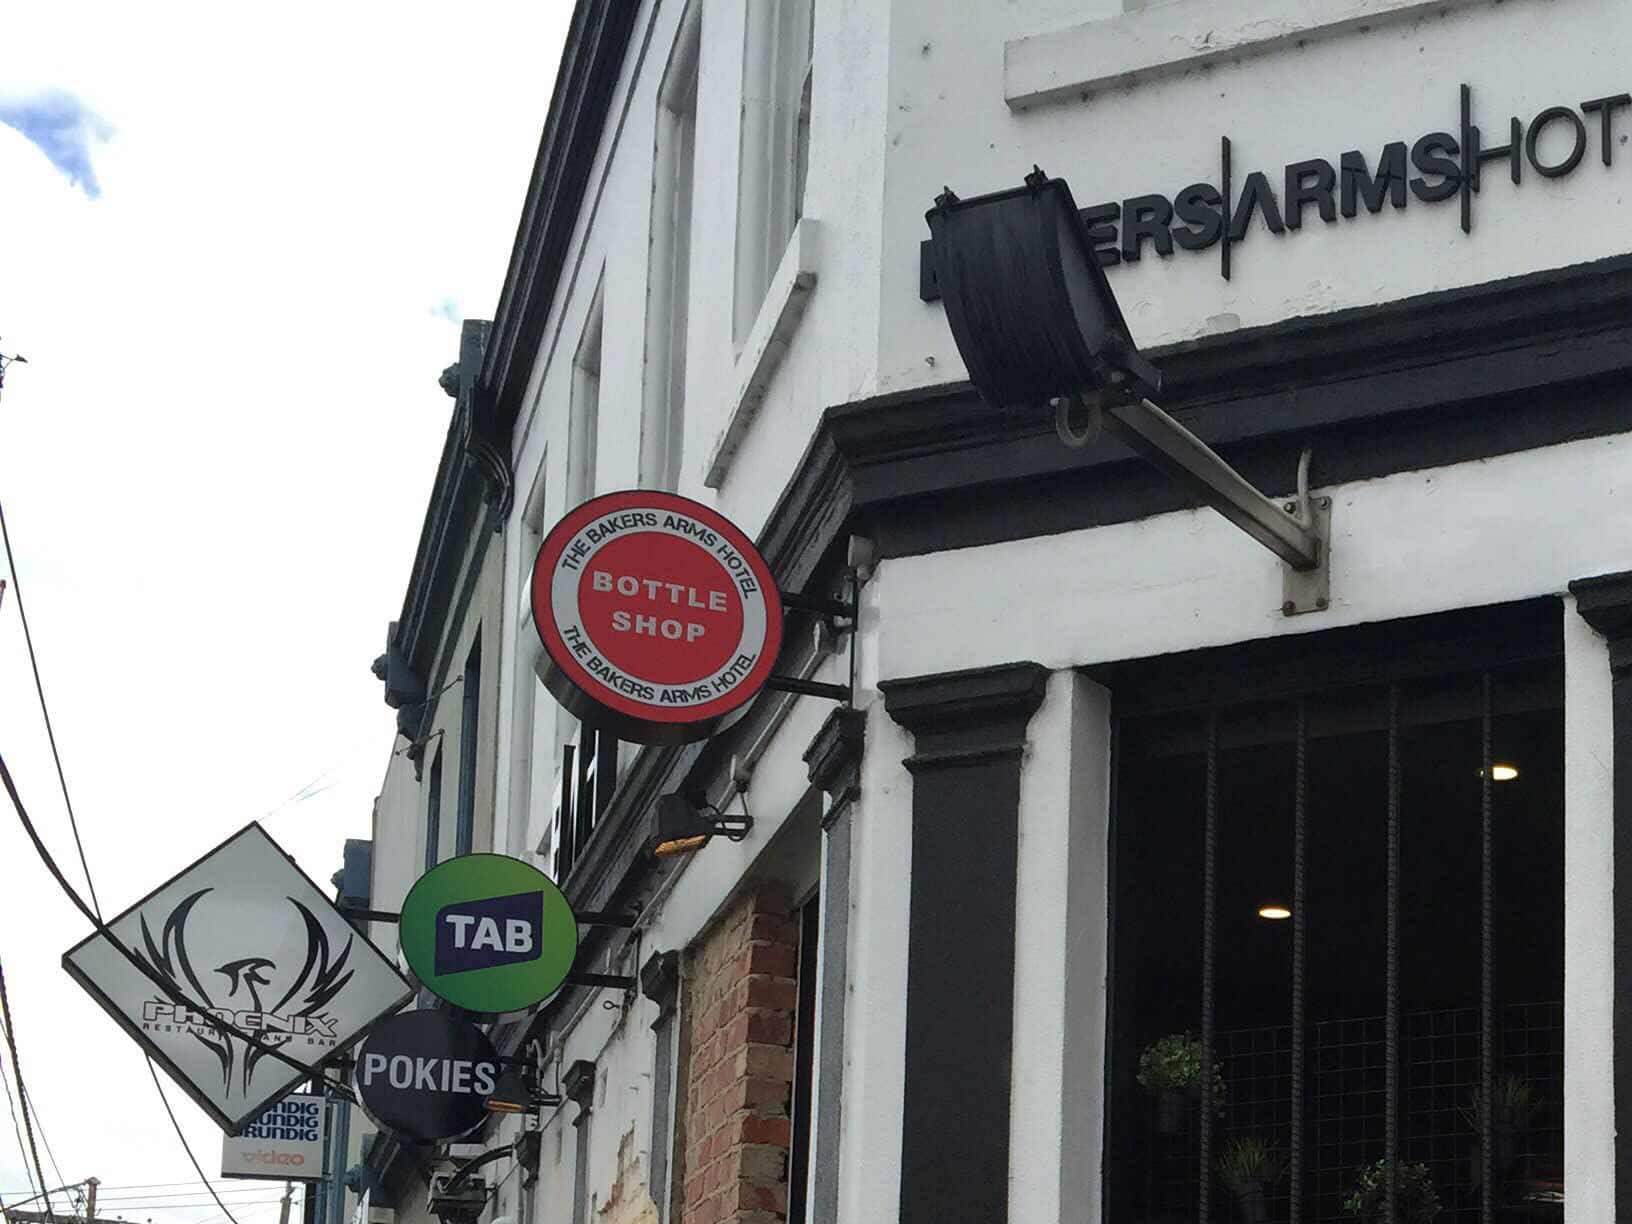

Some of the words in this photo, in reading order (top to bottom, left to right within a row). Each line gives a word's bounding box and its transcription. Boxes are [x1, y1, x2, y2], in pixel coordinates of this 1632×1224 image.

[1228, 130, 1462, 243] ARMS
[562, 539, 591, 571] THE
[585, 512, 658, 544] BAKERS
[663, 515, 718, 548] ARMS
[717, 543, 758, 599] HOTEL
[592, 570, 728, 612] BOTTLE
[612, 611, 706, 643] SHOP
[564, 625, 592, 659] THE
[586, 656, 655, 700] BAKERS
[659, 685, 712, 704] ARMS
[711, 653, 757, 693] HOTEL
[445, 914, 533, 953] TAB
[308, 1038, 336, 1047] BAR
[363, 1053, 496, 1096] POKIES
